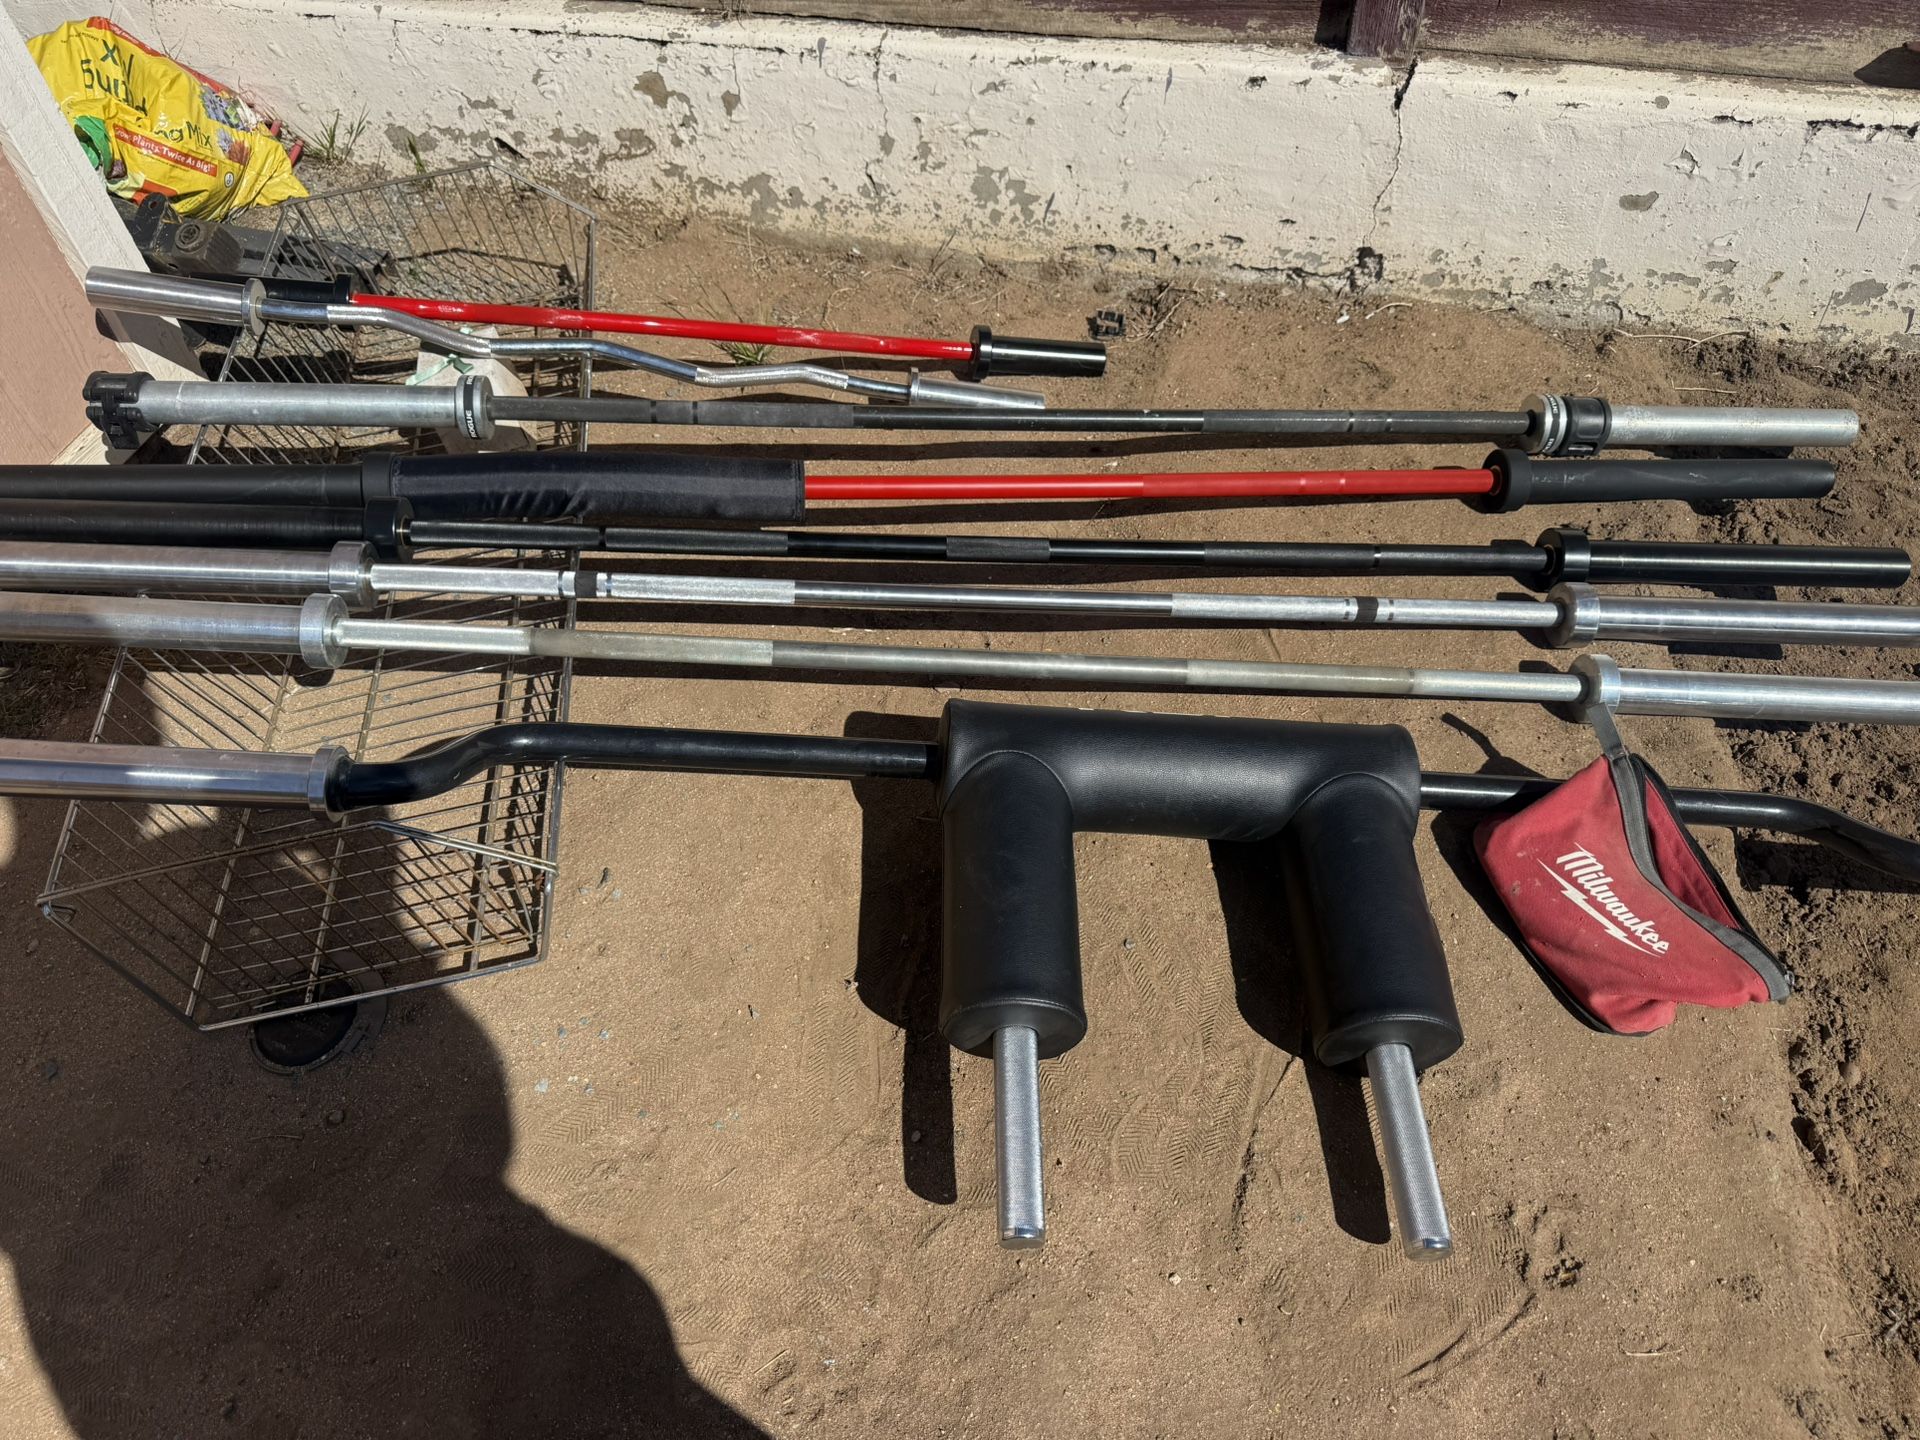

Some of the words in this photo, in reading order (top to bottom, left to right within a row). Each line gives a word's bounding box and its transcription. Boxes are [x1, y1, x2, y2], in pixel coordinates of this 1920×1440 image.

[186, 121, 212, 149] Mix
[132, 135, 160, 153] Plants
[162, 146, 185, 162] Twice
[186, 157, 195, 165] As
[465, 409, 478, 438] ROGUE
[1556, 842, 1670, 954] Milwaukee
